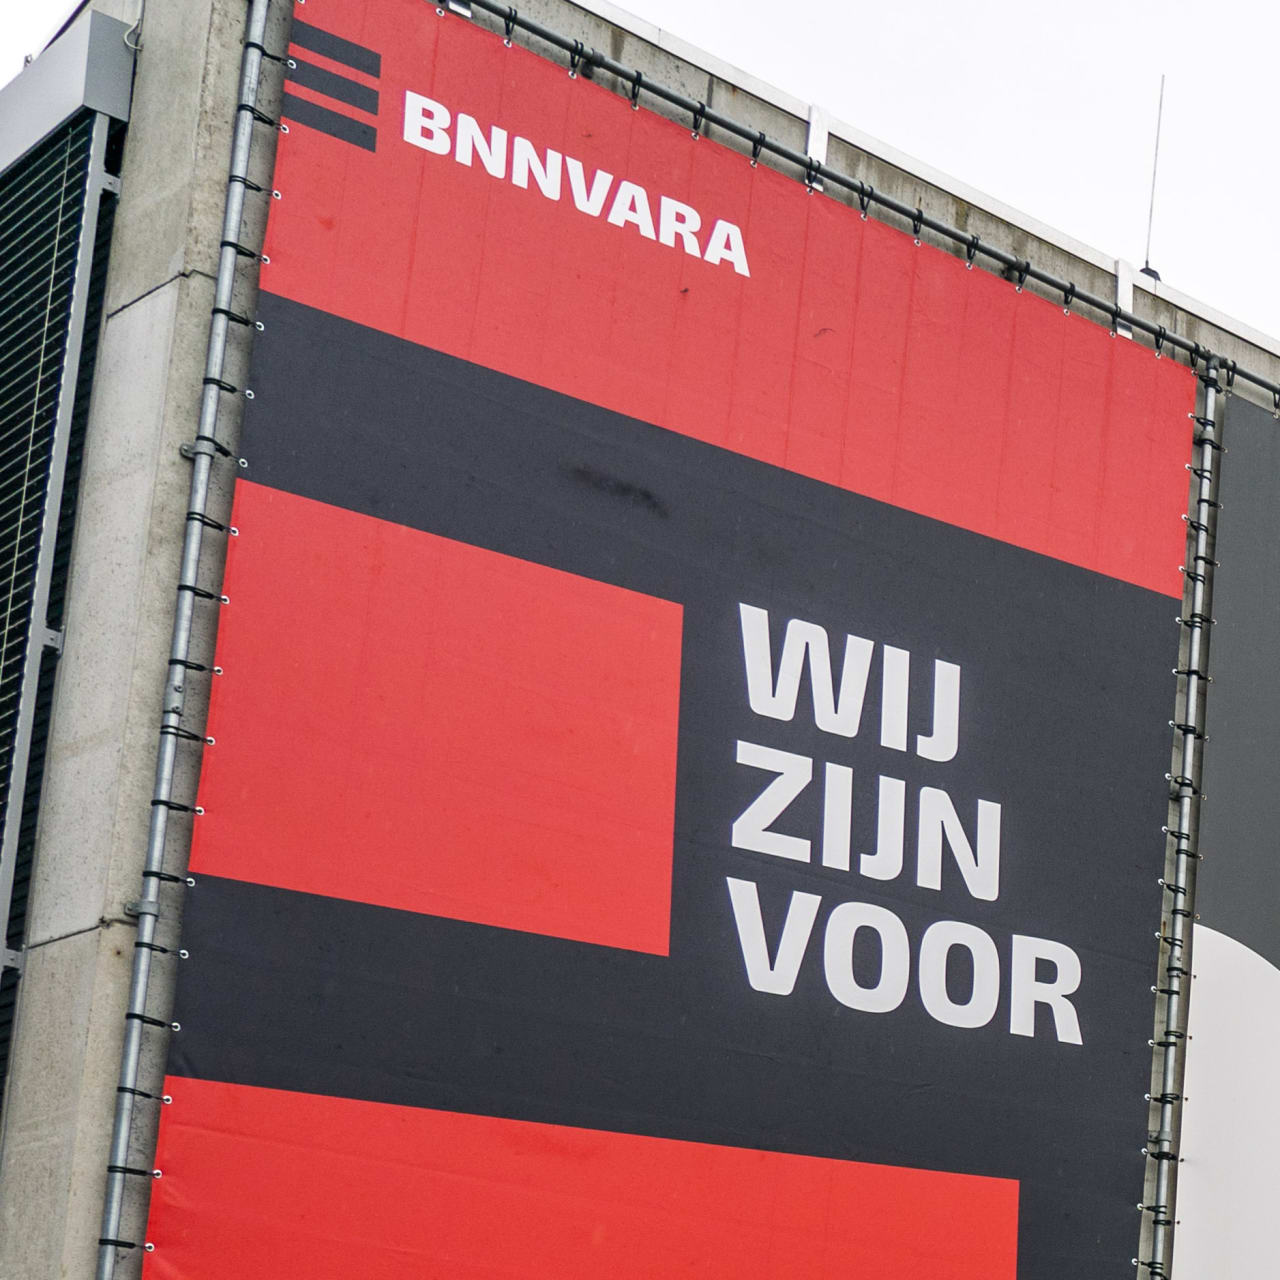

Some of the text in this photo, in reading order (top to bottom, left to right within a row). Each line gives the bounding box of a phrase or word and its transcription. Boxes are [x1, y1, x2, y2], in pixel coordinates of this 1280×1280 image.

[403, 89, 751, 278] BNNVARA
[738, 601, 961, 763] WIJ
[731, 739, 1002, 902] ZIJN
[725, 875, 1084, 1046] VOOR
